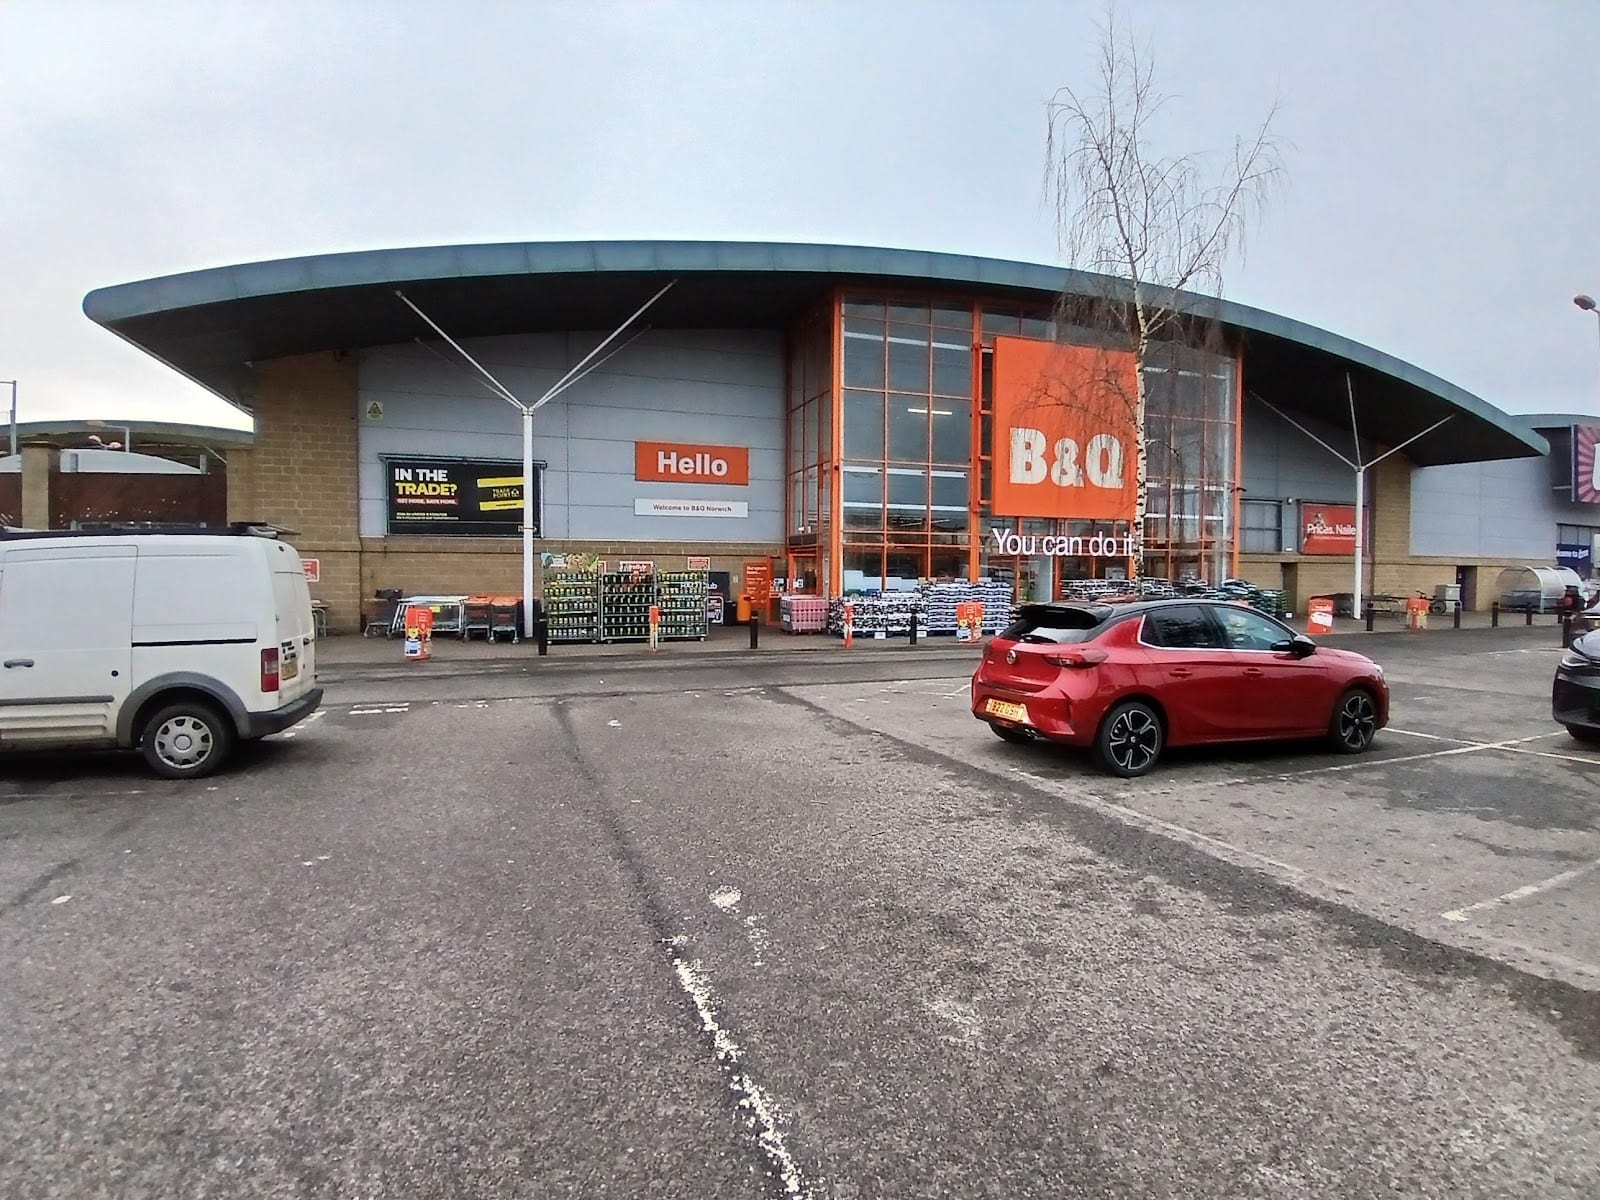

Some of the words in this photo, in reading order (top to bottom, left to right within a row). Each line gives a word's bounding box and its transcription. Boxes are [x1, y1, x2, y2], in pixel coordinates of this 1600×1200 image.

[657, 451, 728, 476] Hello
[1010, 426, 1124, 489] B&Q
[394, 468, 412, 482] IN
[416, 468, 448, 482] THE
[395, 482, 458, 496] TRADE?
[653, 503, 681, 511] Welcome
[992, 528, 1035, 555] You
[1042, 534, 1082, 556] can
[1089, 531, 1117, 557] do
[1123, 531, 1135, 557] it
